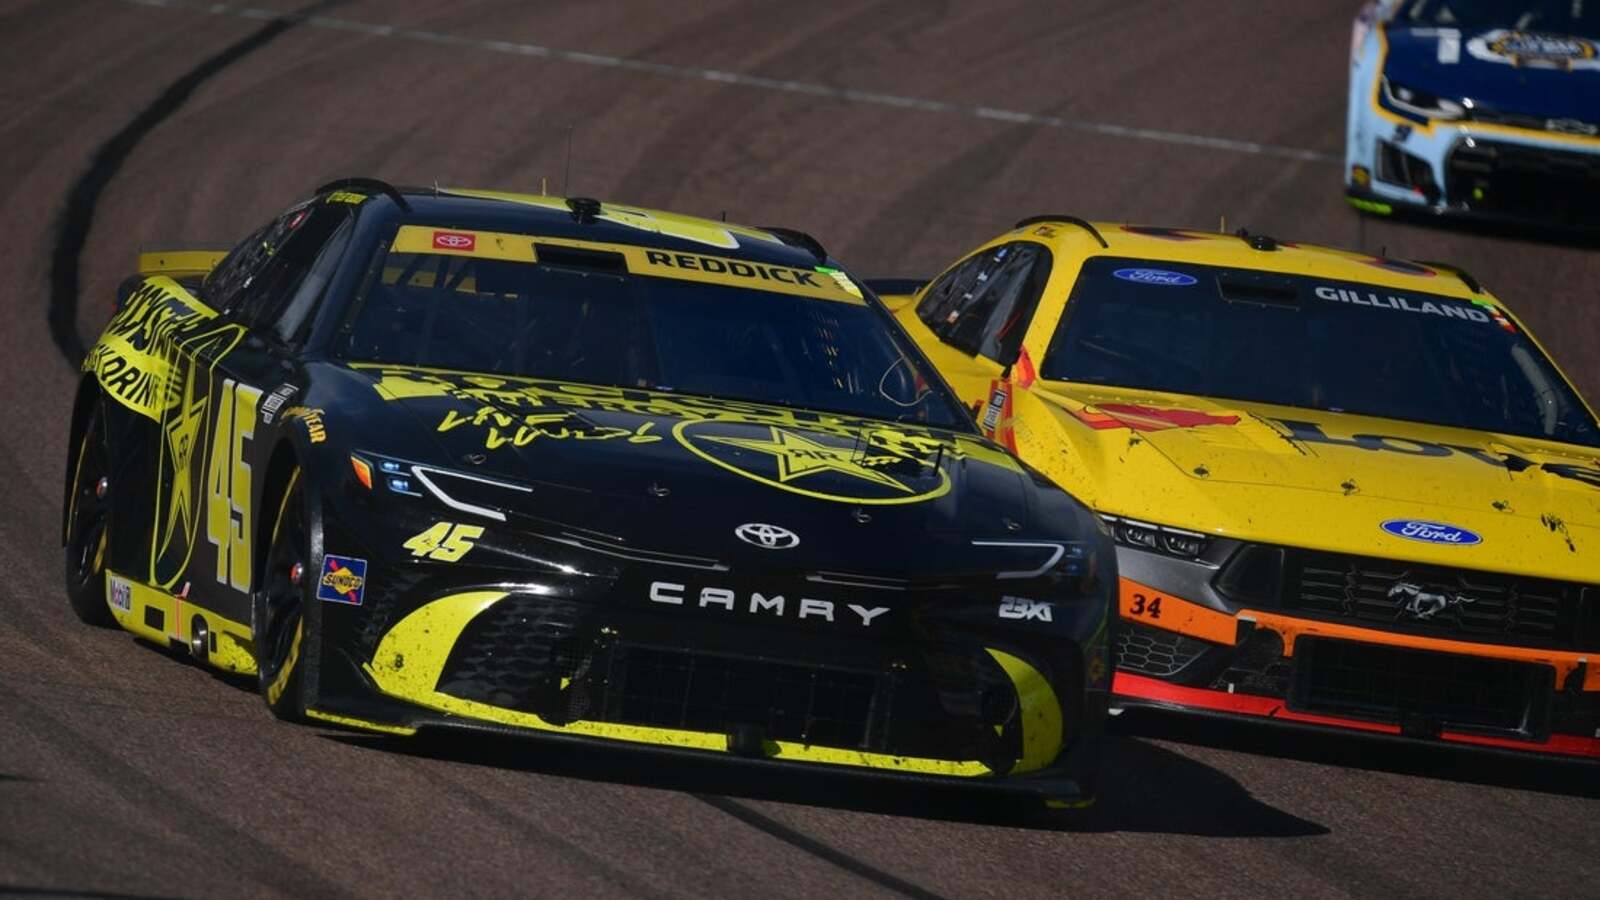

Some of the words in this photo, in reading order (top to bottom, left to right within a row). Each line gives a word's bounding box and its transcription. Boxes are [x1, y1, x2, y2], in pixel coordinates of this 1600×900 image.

[645, 250, 822, 288] REDDICK
[1315, 286, 1490, 323] GILLILAND
[208, 378, 264, 594] 45
[402, 521, 486, 563] 45
[1401, 520, 1464, 544] Ford
[323, 573, 363, 590] SUNOCO
[649, 580, 891, 627] CAMRY
[1130, 592, 1162, 619] 34
